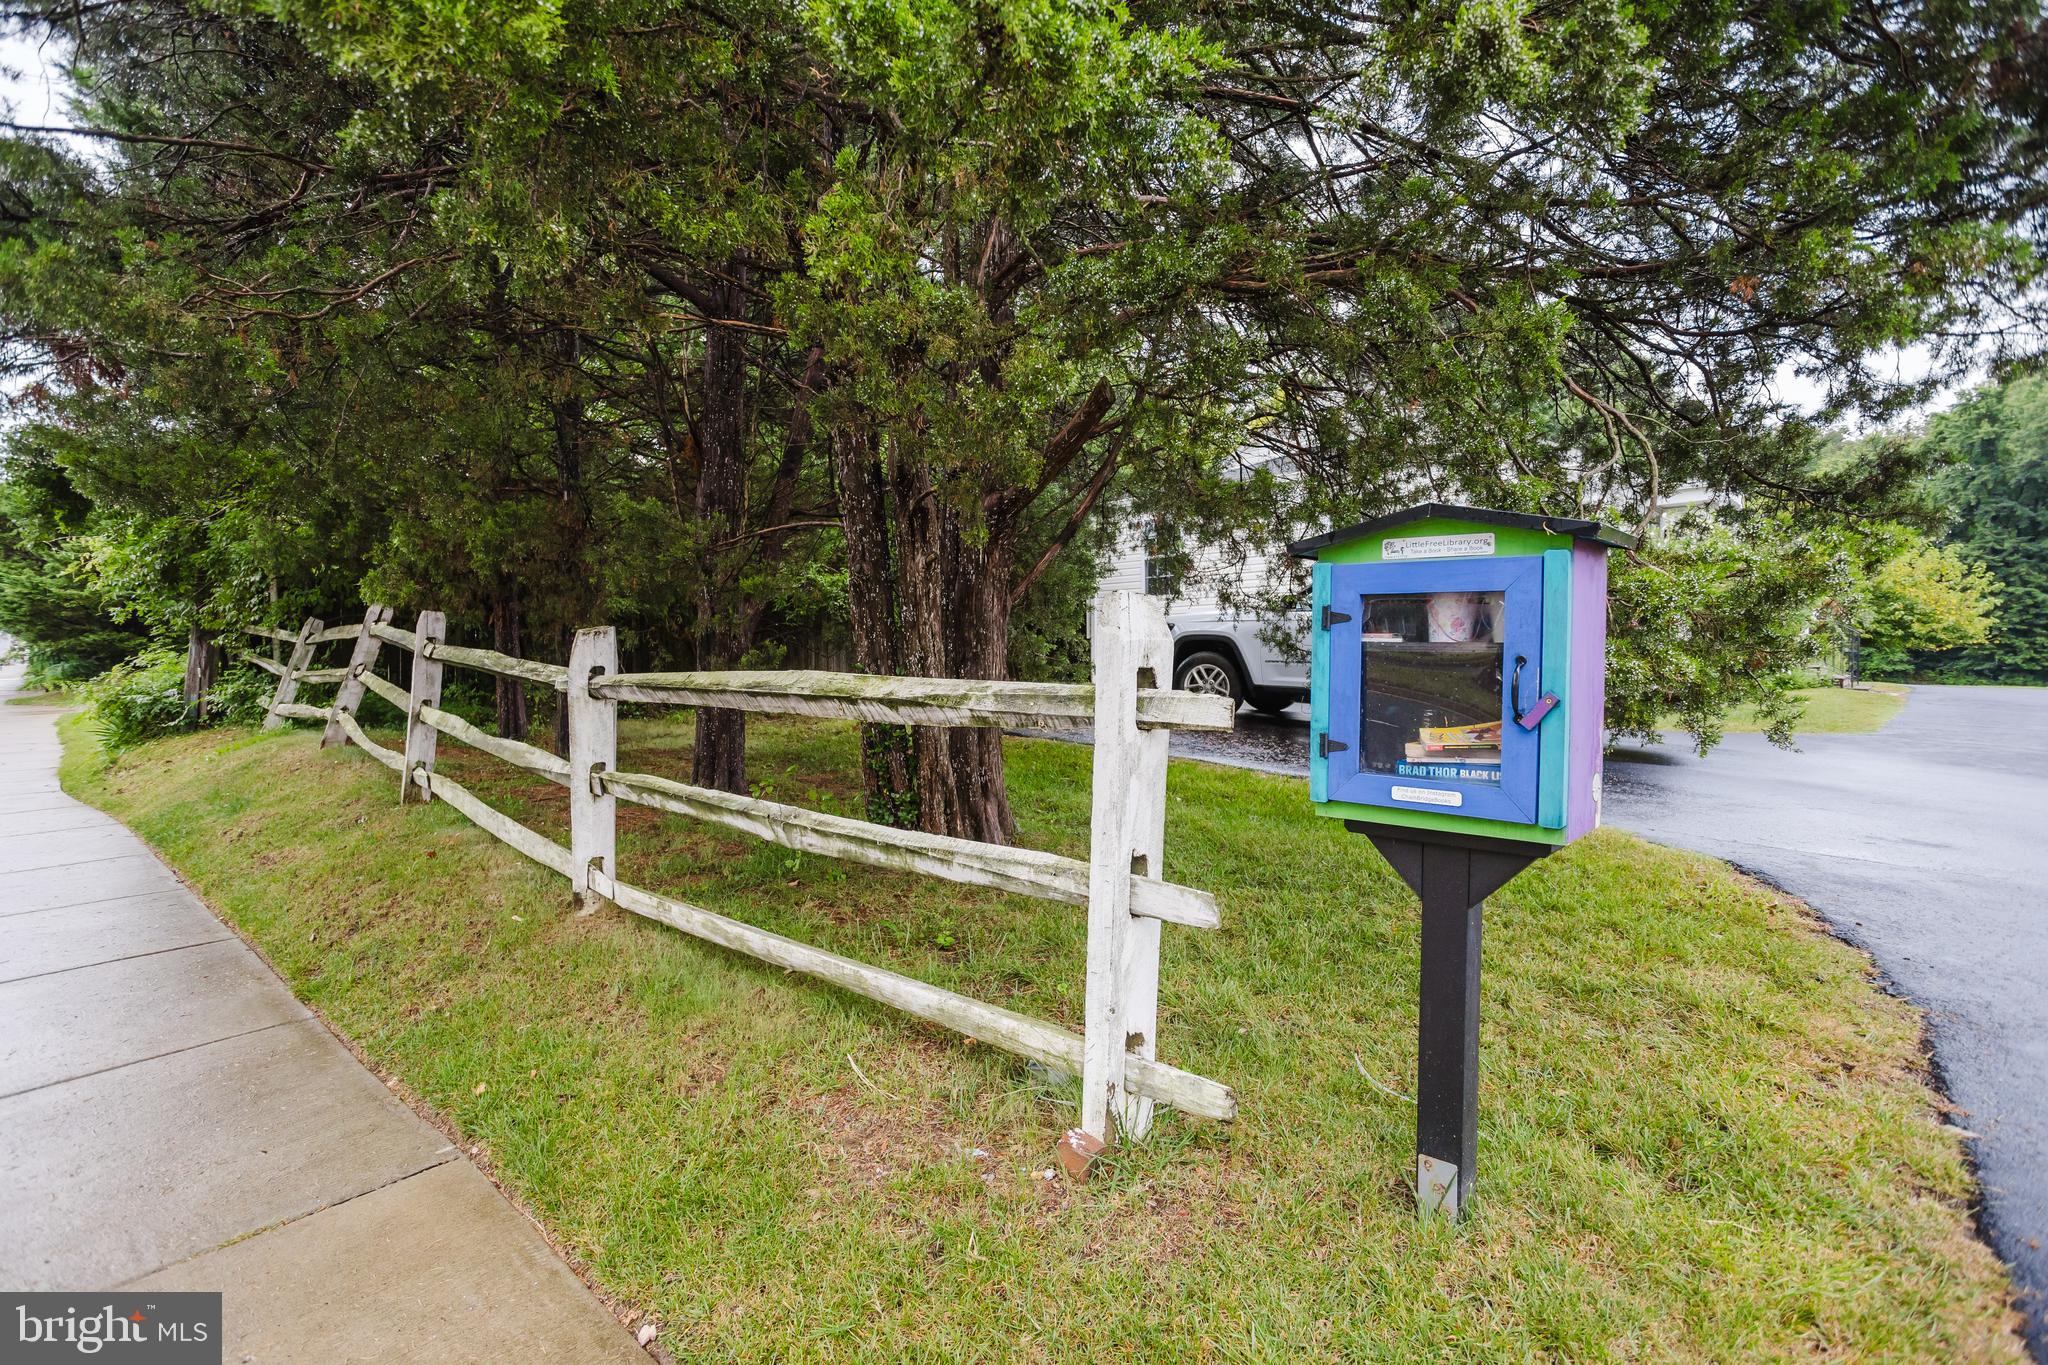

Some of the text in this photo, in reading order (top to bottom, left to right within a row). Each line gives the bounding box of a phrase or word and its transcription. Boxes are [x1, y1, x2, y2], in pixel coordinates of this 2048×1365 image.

[1405, 538, 1489, 548] LittleFreeLibrary.org
[1398, 764, 1426, 777] BRAD
[1427, 766, 1458, 778] THOR
[1459, 769, 1489, 780] BLACK
